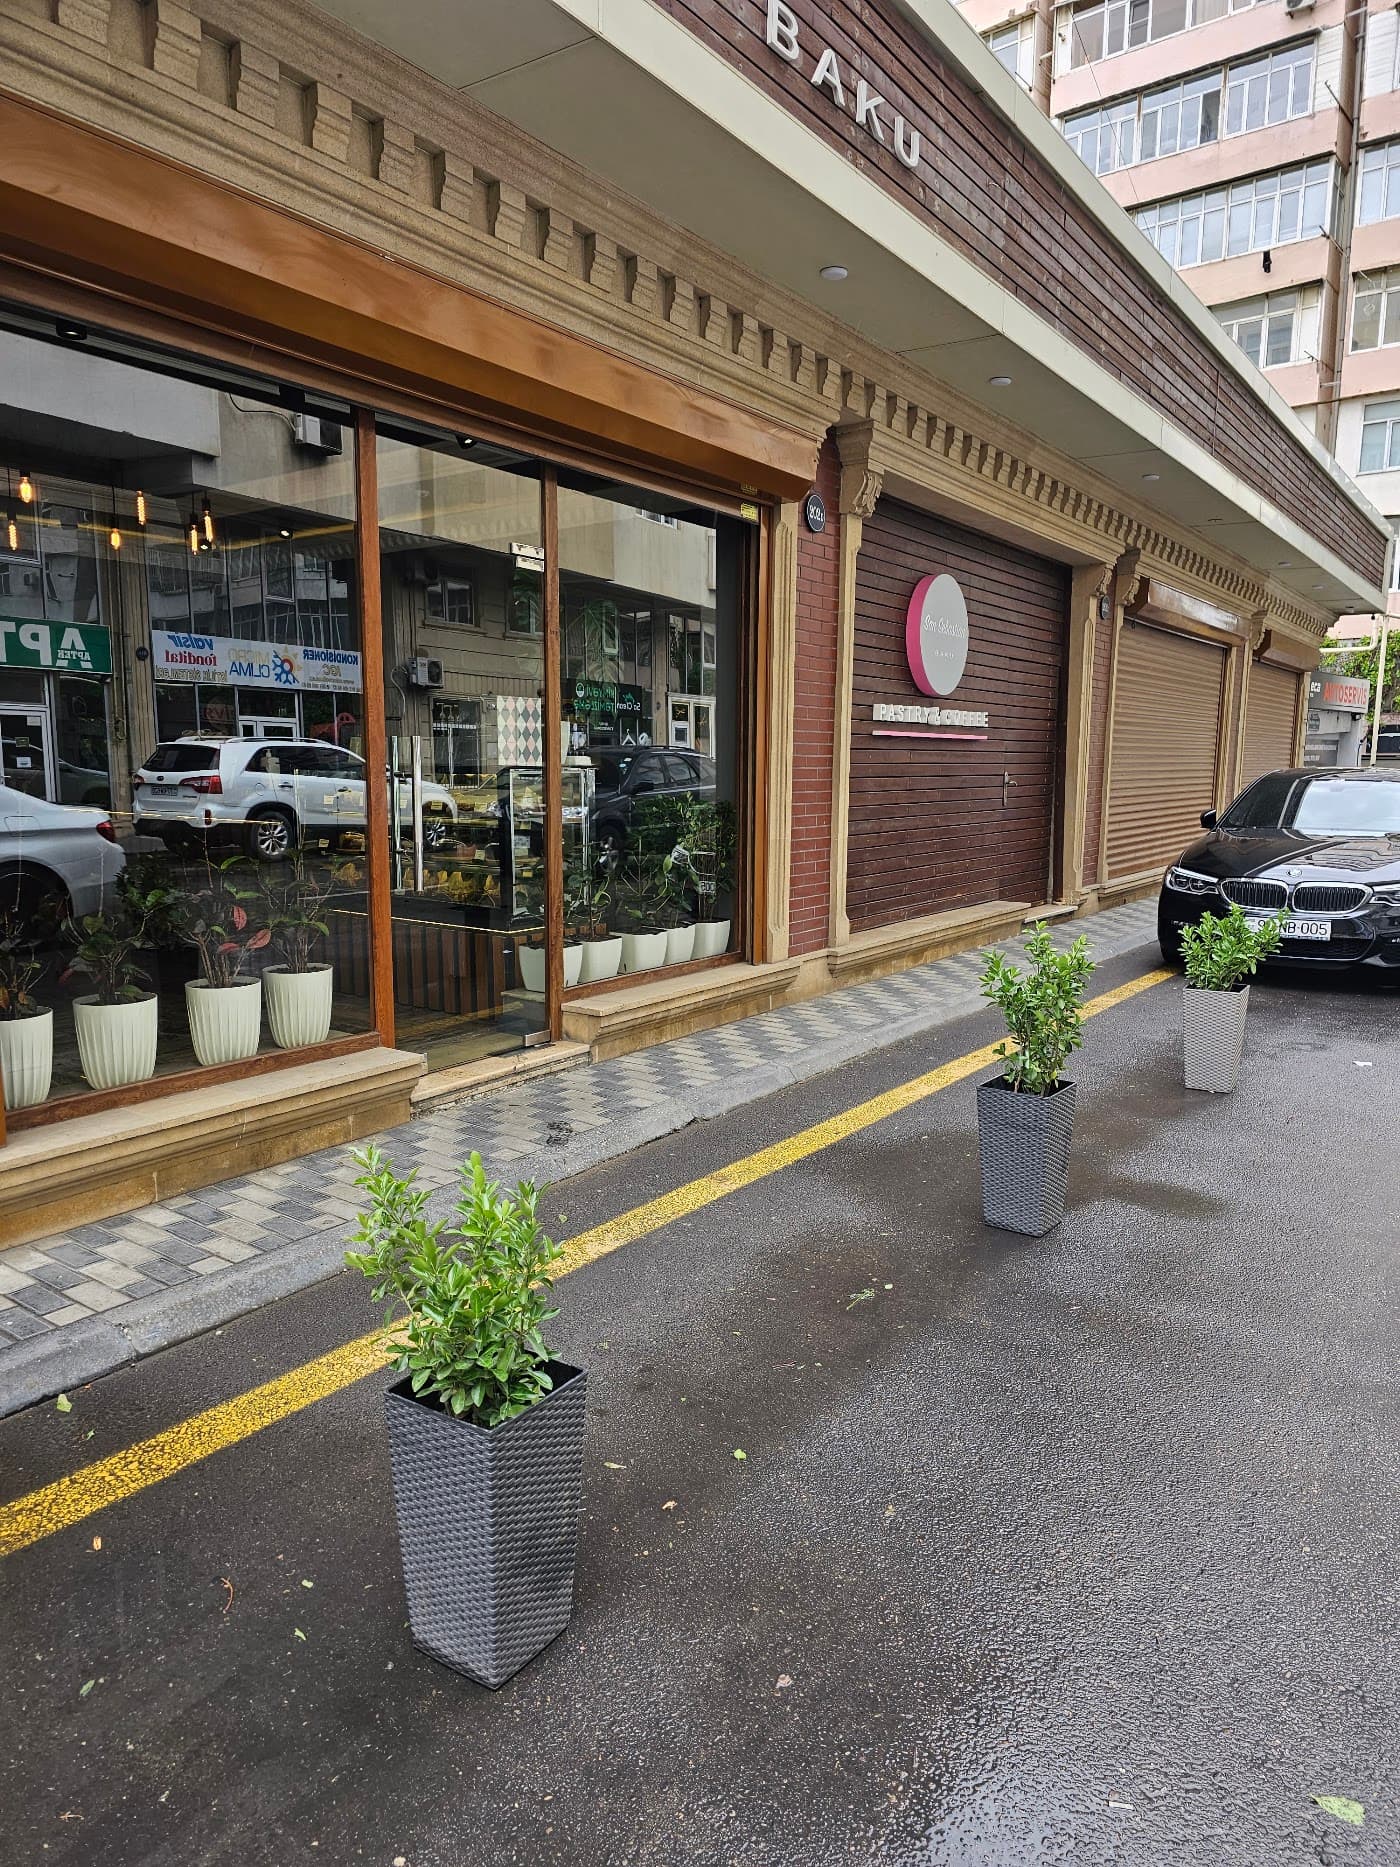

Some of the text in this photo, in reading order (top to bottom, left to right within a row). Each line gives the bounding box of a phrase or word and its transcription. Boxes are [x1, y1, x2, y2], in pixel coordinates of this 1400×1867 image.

[767, 0, 921, 169] BAKU
[873, 703, 928, 723] PASTRY
[940, 709, 988, 727] COFFEE
